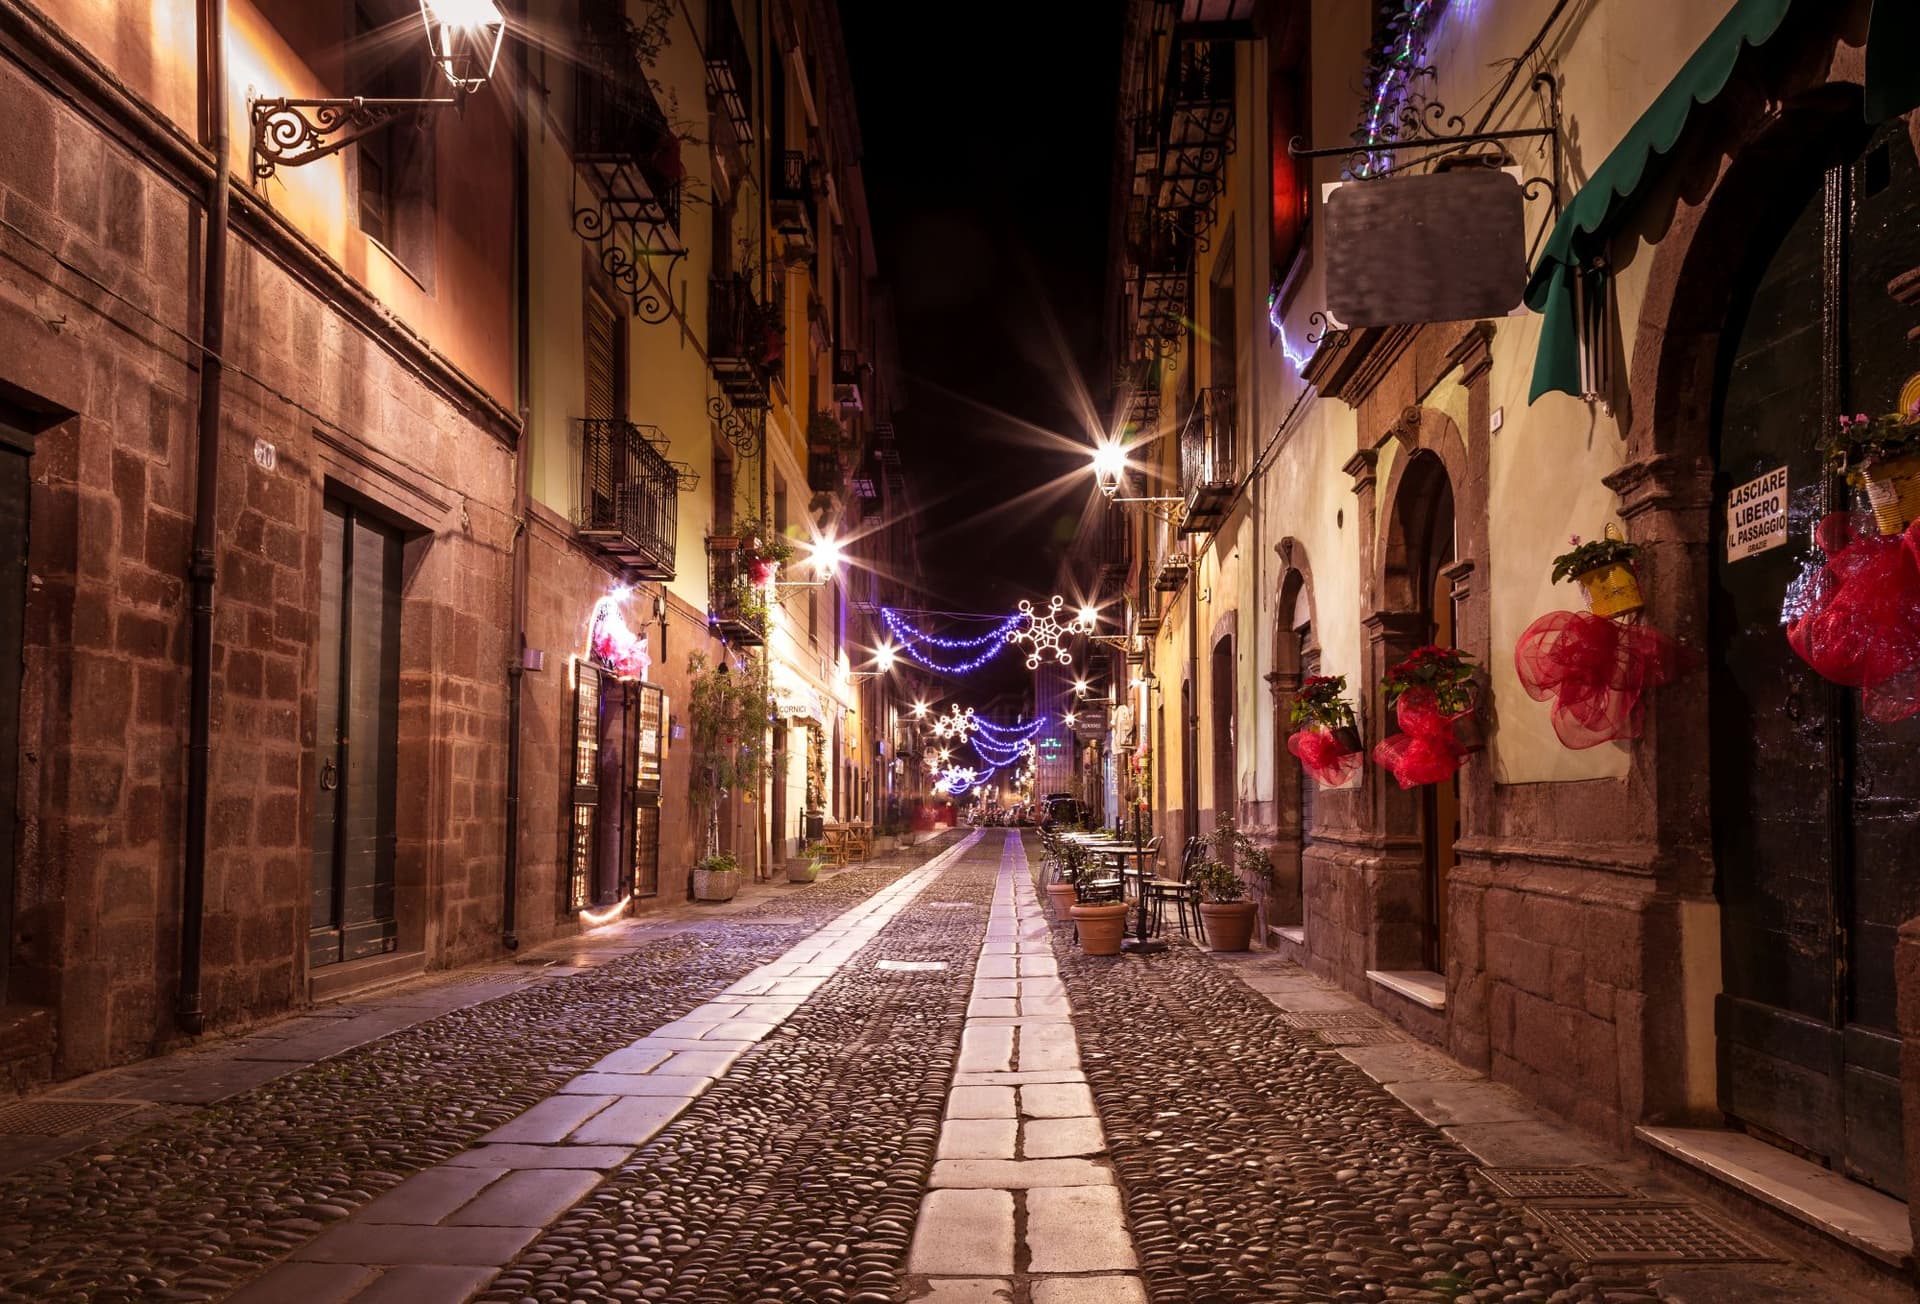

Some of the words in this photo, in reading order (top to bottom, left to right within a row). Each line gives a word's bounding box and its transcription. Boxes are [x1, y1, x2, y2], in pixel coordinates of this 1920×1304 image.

[1729, 469, 1786, 509] LASCIARE
[1735, 496, 1780, 528] LIBERO
[1728, 535, 1737, 549] IL
[1737, 515, 1786, 545] PASSAGGIO
[1747, 540, 1768, 553] GRAZIE
